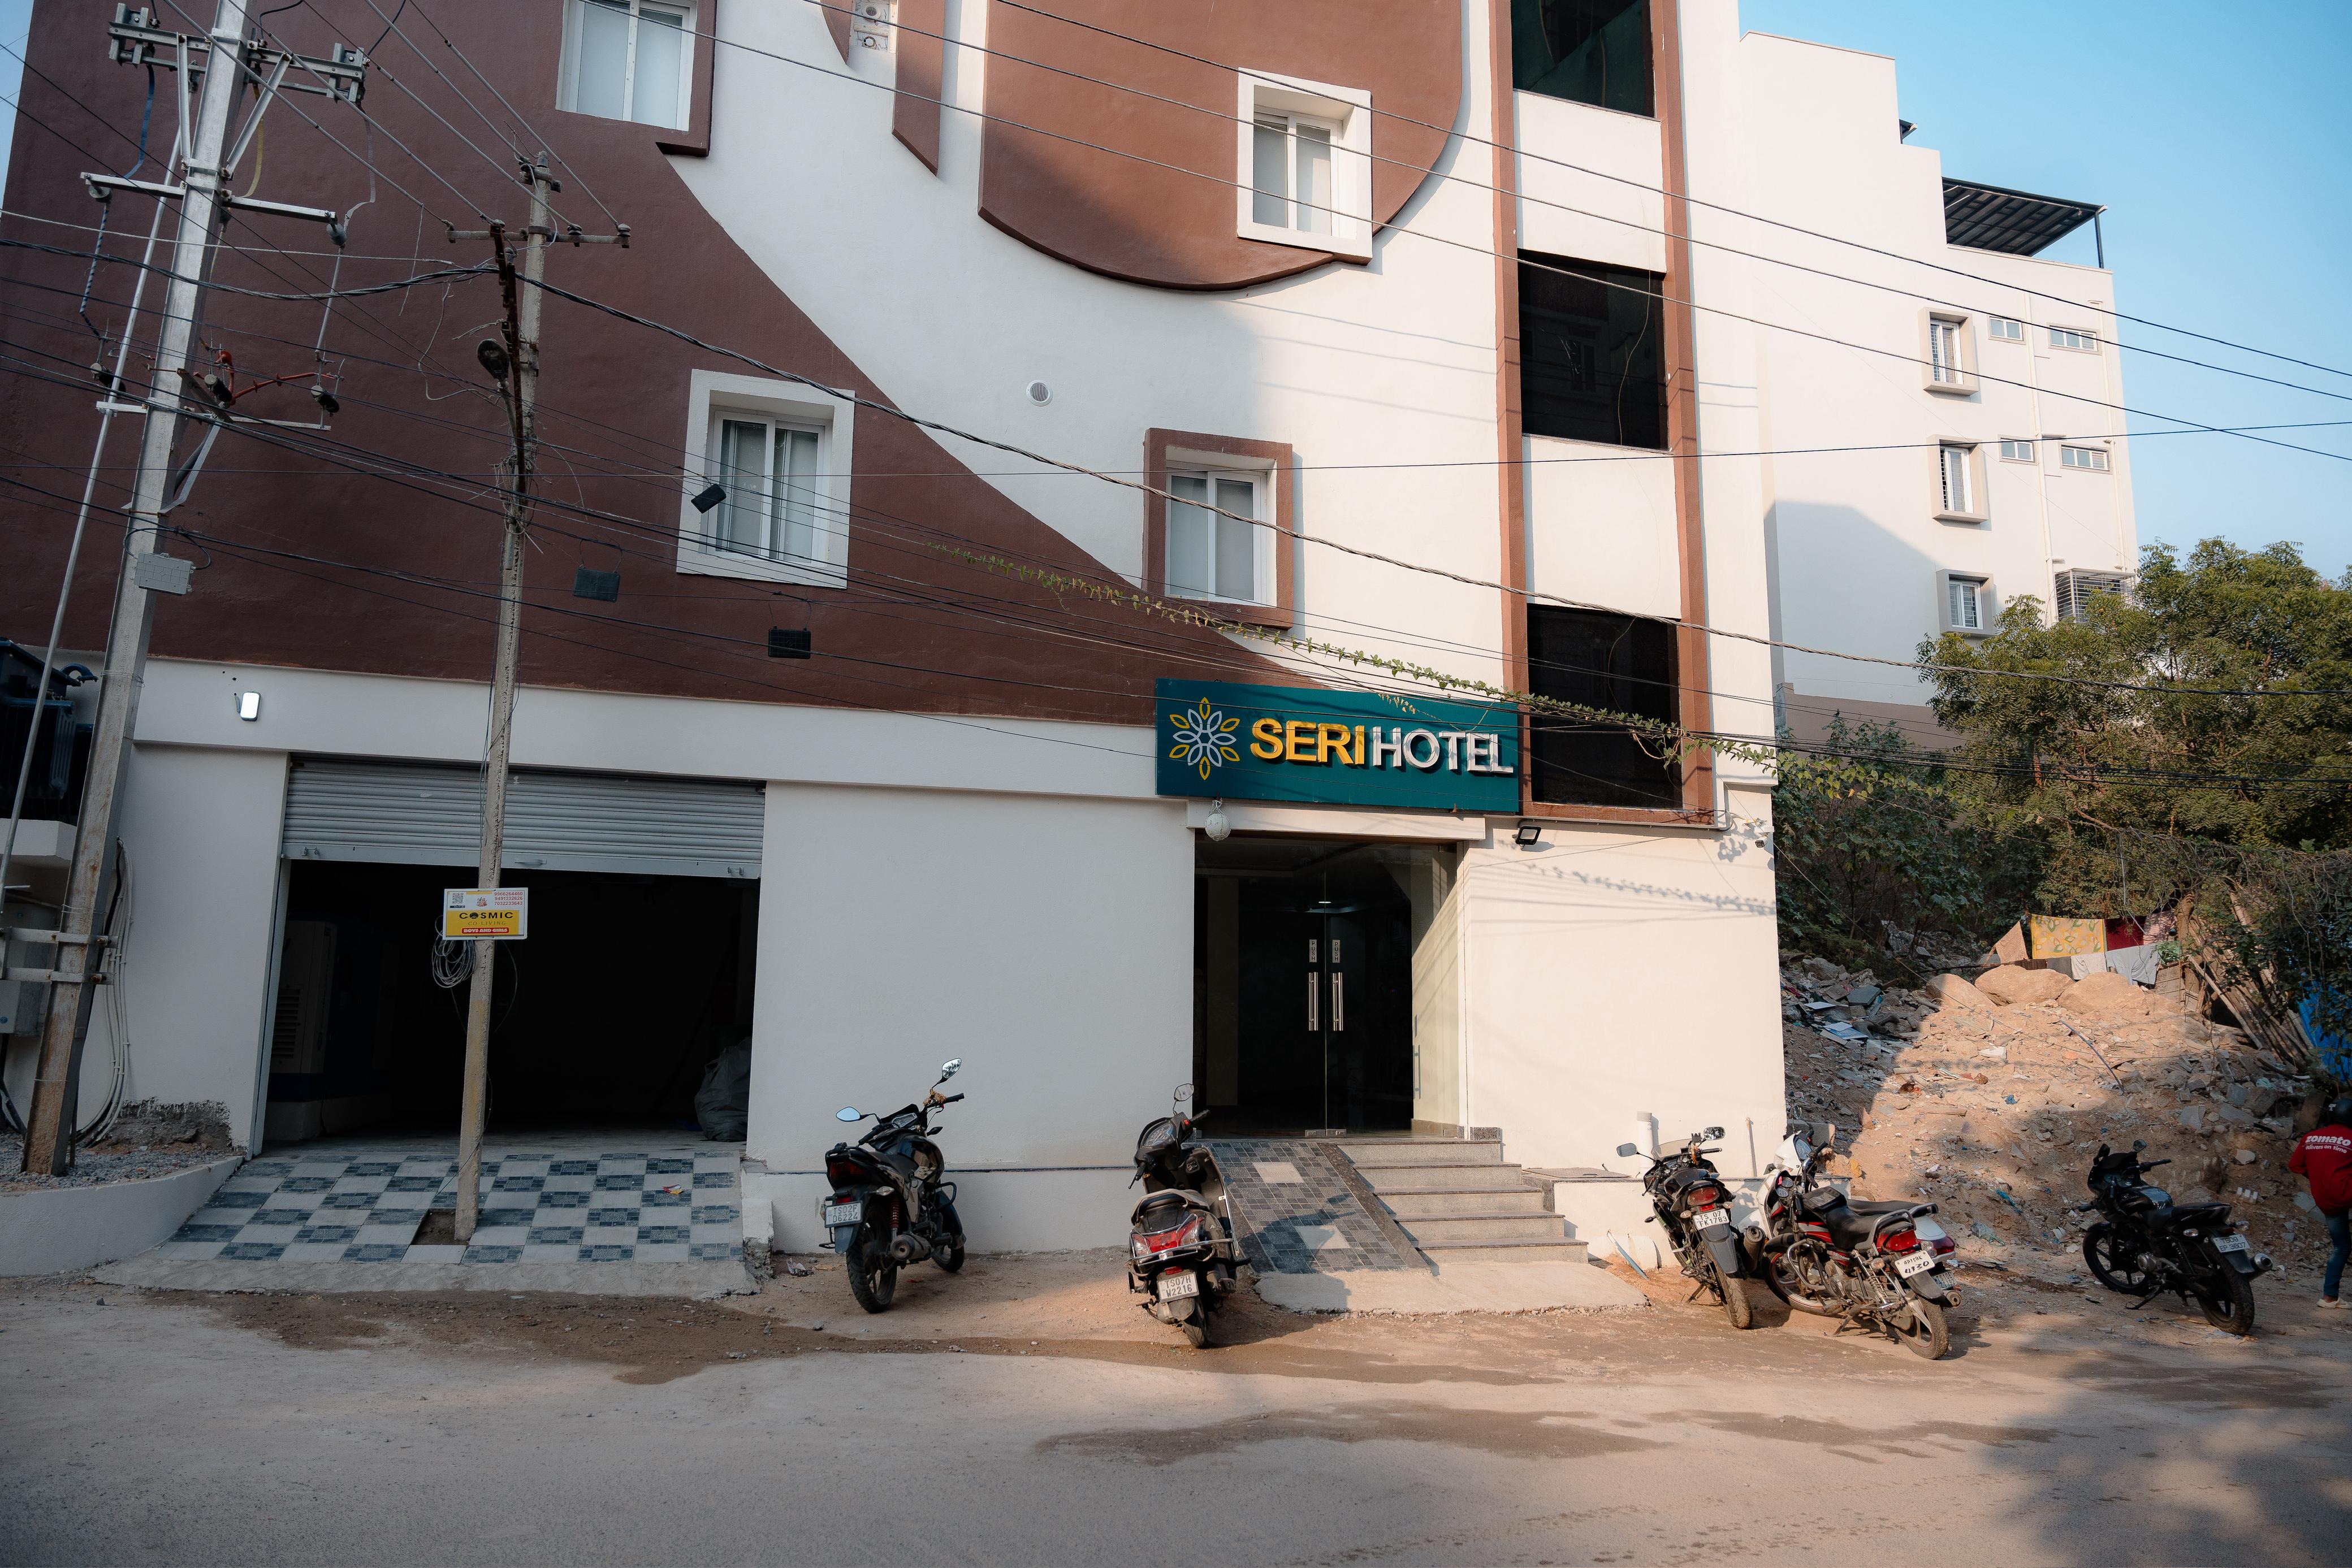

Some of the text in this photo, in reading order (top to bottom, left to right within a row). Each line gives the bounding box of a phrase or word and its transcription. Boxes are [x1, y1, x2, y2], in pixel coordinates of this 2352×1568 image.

[1251, 718, 1514, 774] SERI HOTEL
[2305, 1135, 2351, 1146] zomato
[833, 1205, 858, 1215] TS02F
[833, 1211, 858, 1223] D6224
[1698, 1216, 1727, 1227] FK1783
[1165, 1275, 1191, 1289] TS07H
[1166, 1284, 1192, 1297] W2216
